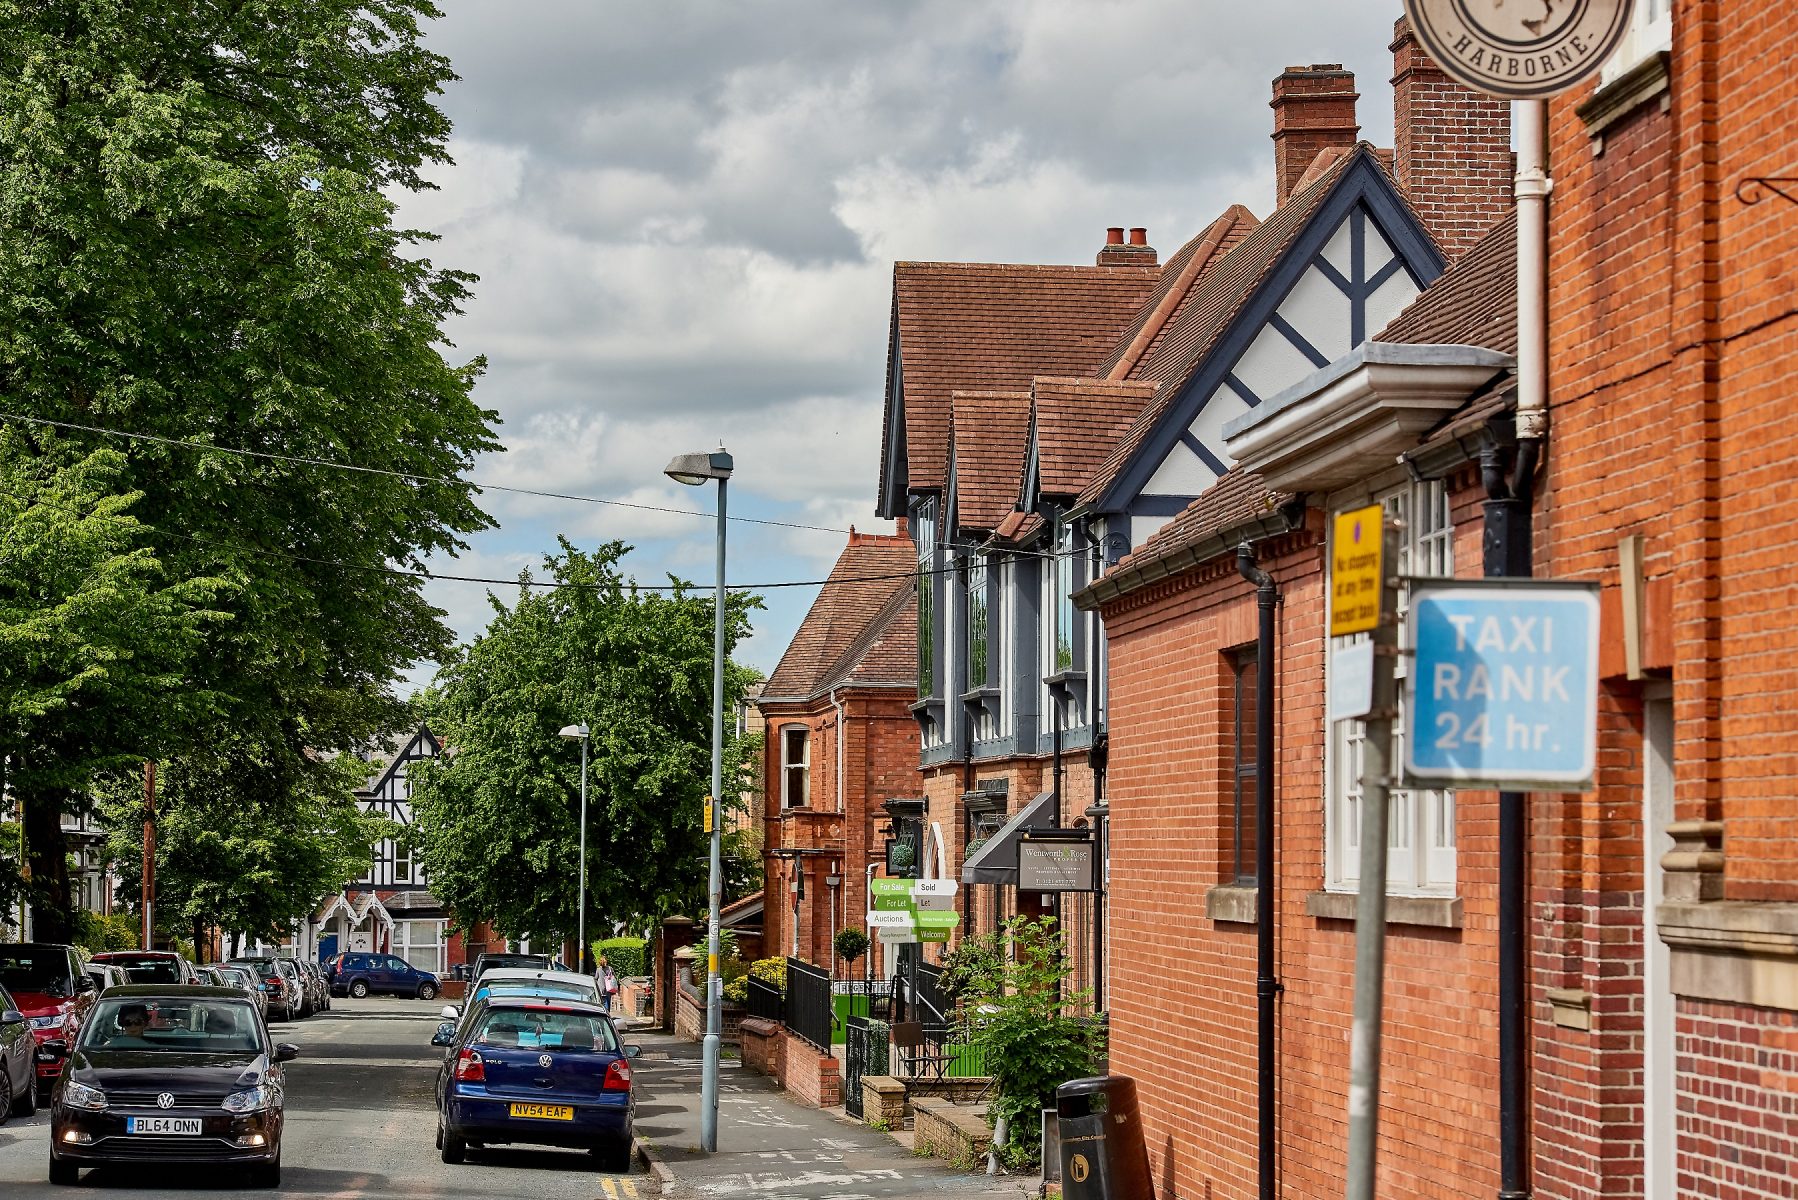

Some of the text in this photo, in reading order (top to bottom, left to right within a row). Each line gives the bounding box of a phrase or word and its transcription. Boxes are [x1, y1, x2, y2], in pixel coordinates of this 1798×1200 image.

[1452, 34, 1588, 77] HARBORNE
[1448, 614, 1553, 653] TAXI
[1432, 663, 1572, 703] RANK
[1434, 710, 1561, 752] 24 hr.
[1025, 849, 1062, 858] Wentworth
[1070, 849, 1087, 858] Rose
[880, 883, 905, 891] For Sale
[920, 883, 936, 891] Sold
[886, 899, 906, 907] For Let
[920, 899, 930, 907] Let
[874, 915, 904, 923] Auctions
[920, 930, 946, 938] Welcome
[515, 1104, 567, 1118] NV54 EAF
[137, 1119, 199, 1133] BL64 ONN
